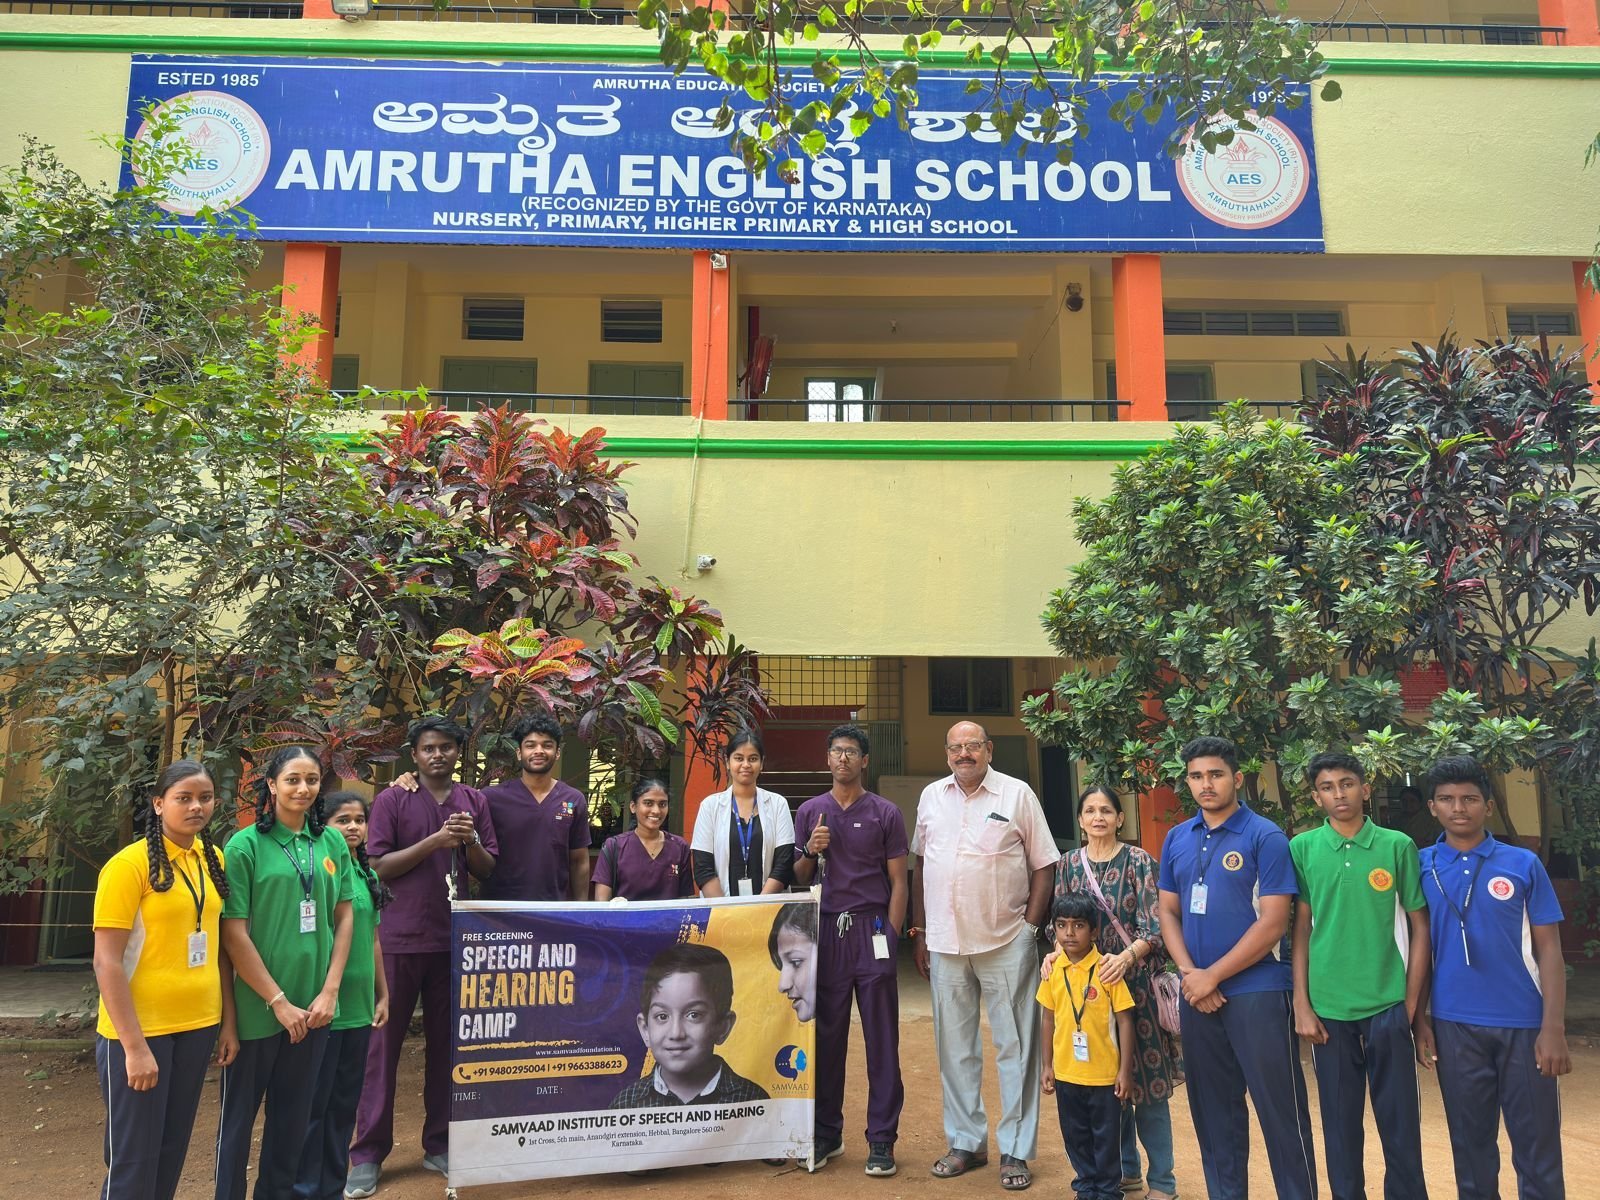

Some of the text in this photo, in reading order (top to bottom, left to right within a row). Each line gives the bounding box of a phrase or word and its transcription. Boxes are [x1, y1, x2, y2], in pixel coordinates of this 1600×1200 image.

[157, 72, 260, 87] ESTED 1985
[593, 78, 671, 90] AMRUTHA
[185, 106, 252, 155] ENGLISH SCHOOL
[372, 92, 622, 157] ಅಮೃತ
[1264, 133, 1291, 169] SCHOOL
[181, 158, 219, 171] AES
[274, 148, 597, 196] AMRUTHA
[618, 154, 891, 200] ENGLISH
[914, 159, 1171, 202] SCHOOL
[1226, 173, 1262, 185] AES
[522, 196, 932, 219] (RECOGNIZED BY THE GOVT OF KARNATAKA)
[1207, 191, 1282, 212] AMRUTHAHALLI
[432, 211, 1018, 235] NURSERY, PRIMARY, HIGHER PRIMARY & HIGH SCHOOL
[462, 931, 534, 941] FREE SCREENING
[461, 943, 577, 971] SPEECH AND
[459, 969, 575, 1009] HEARING
[458, 1012, 517, 1040] CAMP
[771, 1083, 809, 1091] SAMVAAD
[491, 1105, 765, 1137] SAMVAAD INSTITUTE OF SPEECH AND HEARING
